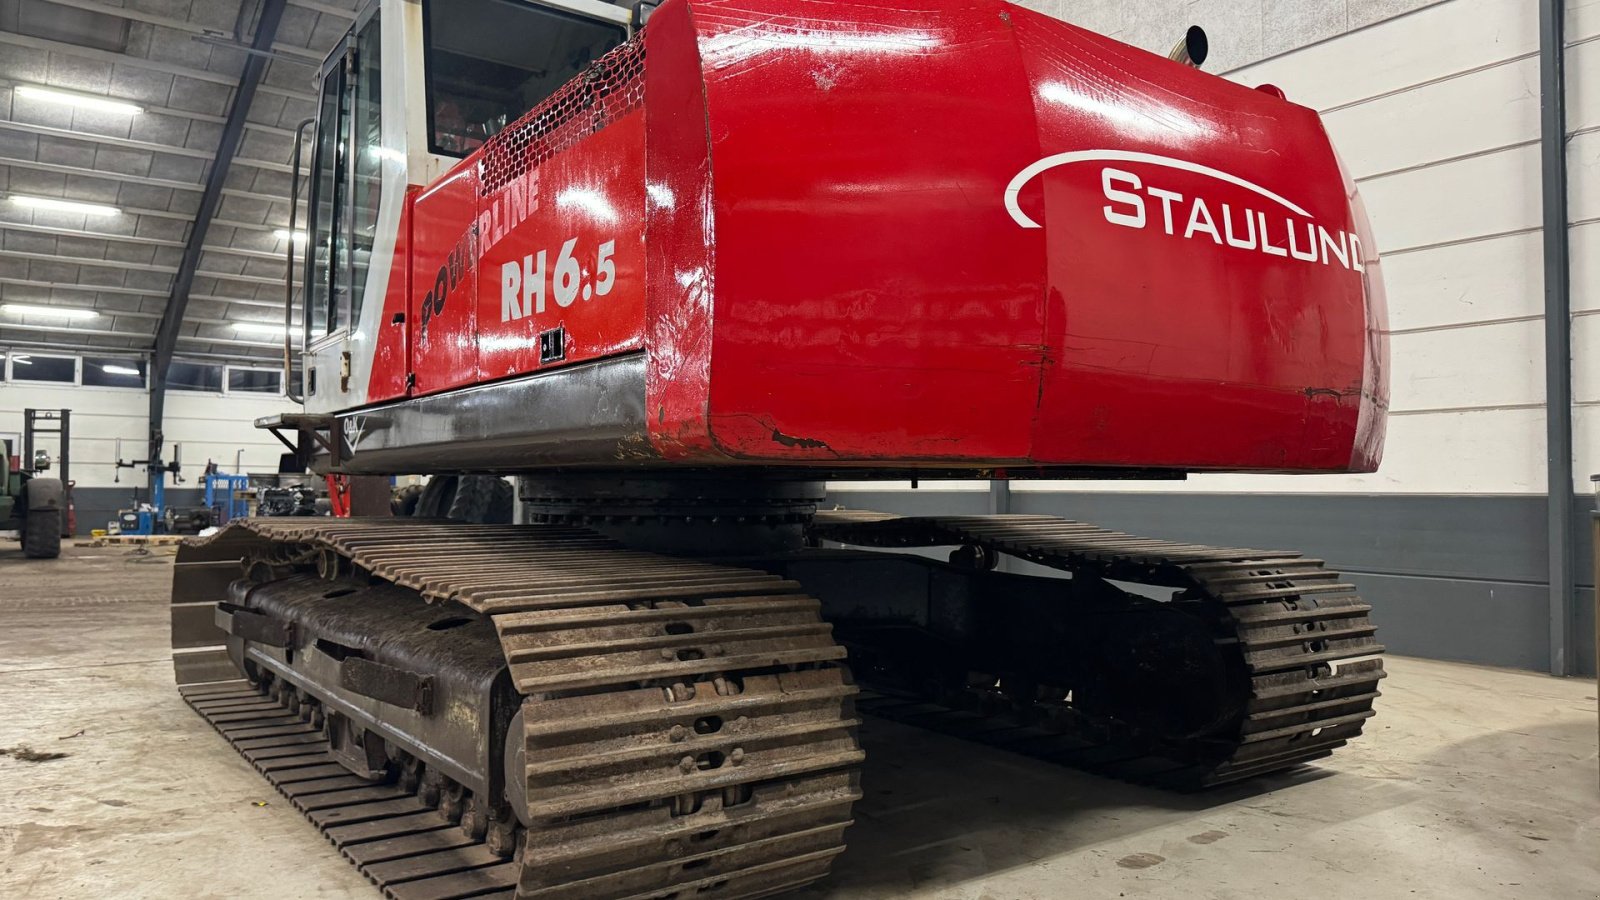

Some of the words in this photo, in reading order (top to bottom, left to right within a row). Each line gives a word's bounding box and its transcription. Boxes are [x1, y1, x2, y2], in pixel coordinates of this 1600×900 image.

[1101, 167, 1365, 273] STAULUND
[501, 249, 547, 322] RH
[552, 236, 616, 307] 6.5
